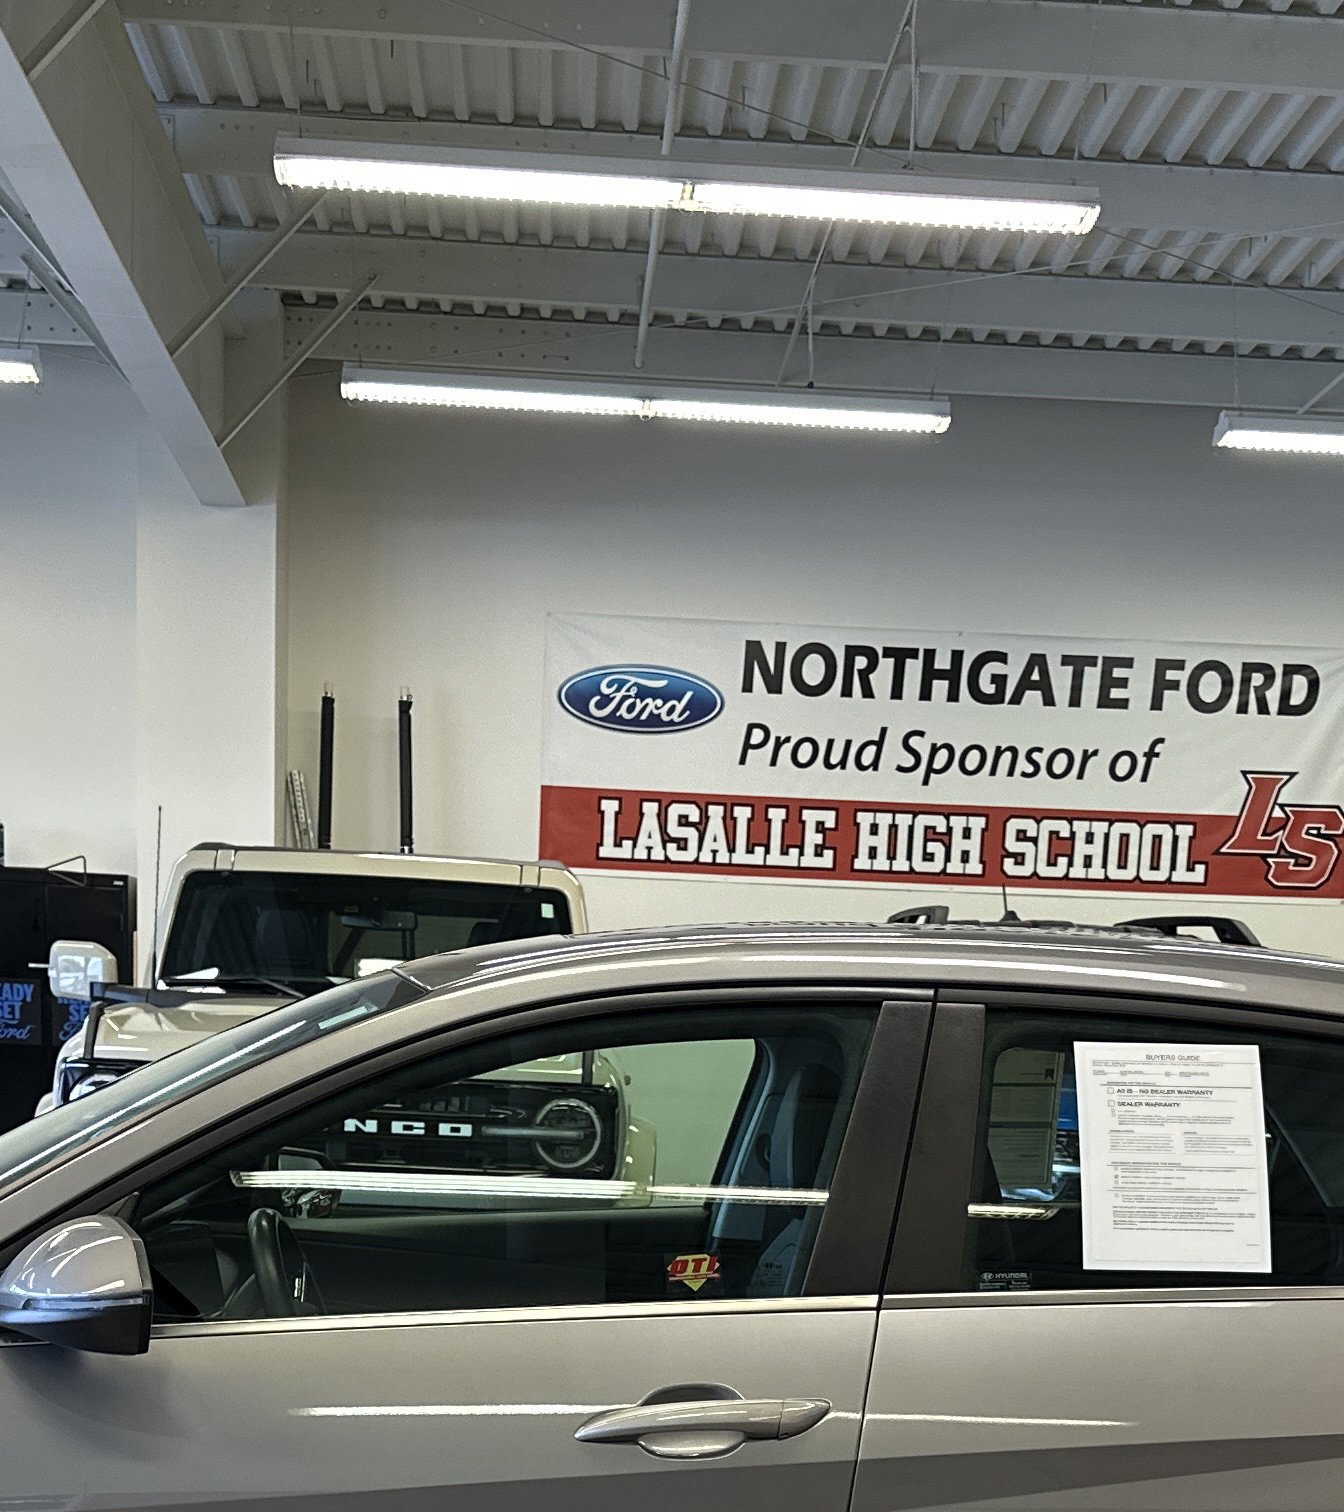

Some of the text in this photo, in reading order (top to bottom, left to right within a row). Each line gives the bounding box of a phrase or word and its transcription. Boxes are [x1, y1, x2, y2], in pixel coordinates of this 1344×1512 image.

[588, 674, 694, 723] Ford
[741, 639, 1320, 717] NORTHGATE FORD
[738, 722, 1166, 787] Proud Sponsor of
[599, 799, 1206, 884] LASALLE HIGH SCHOOL
[68, 1004, 89, 1020] SE
[343, 1118, 473, 1137] NCO
